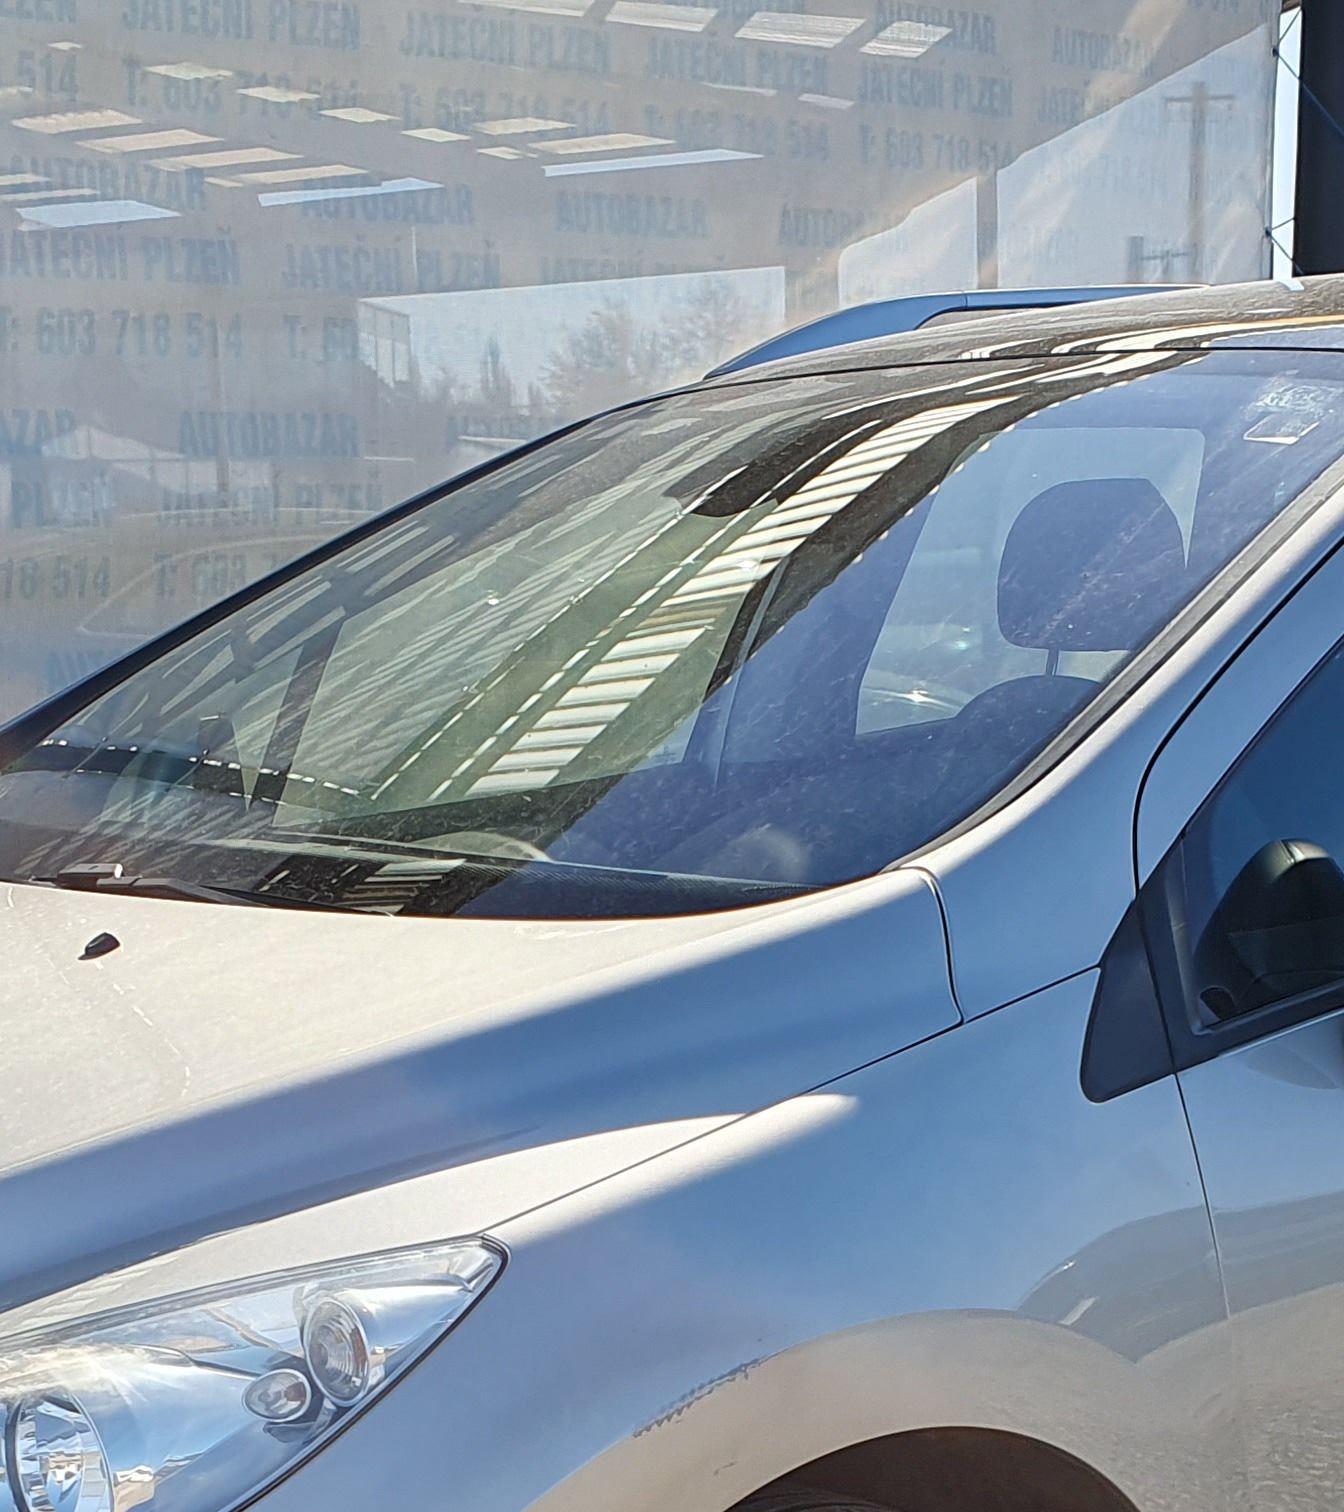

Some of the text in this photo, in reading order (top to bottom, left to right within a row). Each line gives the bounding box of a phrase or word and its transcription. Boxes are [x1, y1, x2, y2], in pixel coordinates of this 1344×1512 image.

[141, 226, 241, 286] PLZEŇ
[36, 306, 96, 356] 603
[111, 308, 172, 358] 718
[186, 311, 244, 361] 514
[52, 555, 113, 600] 514
